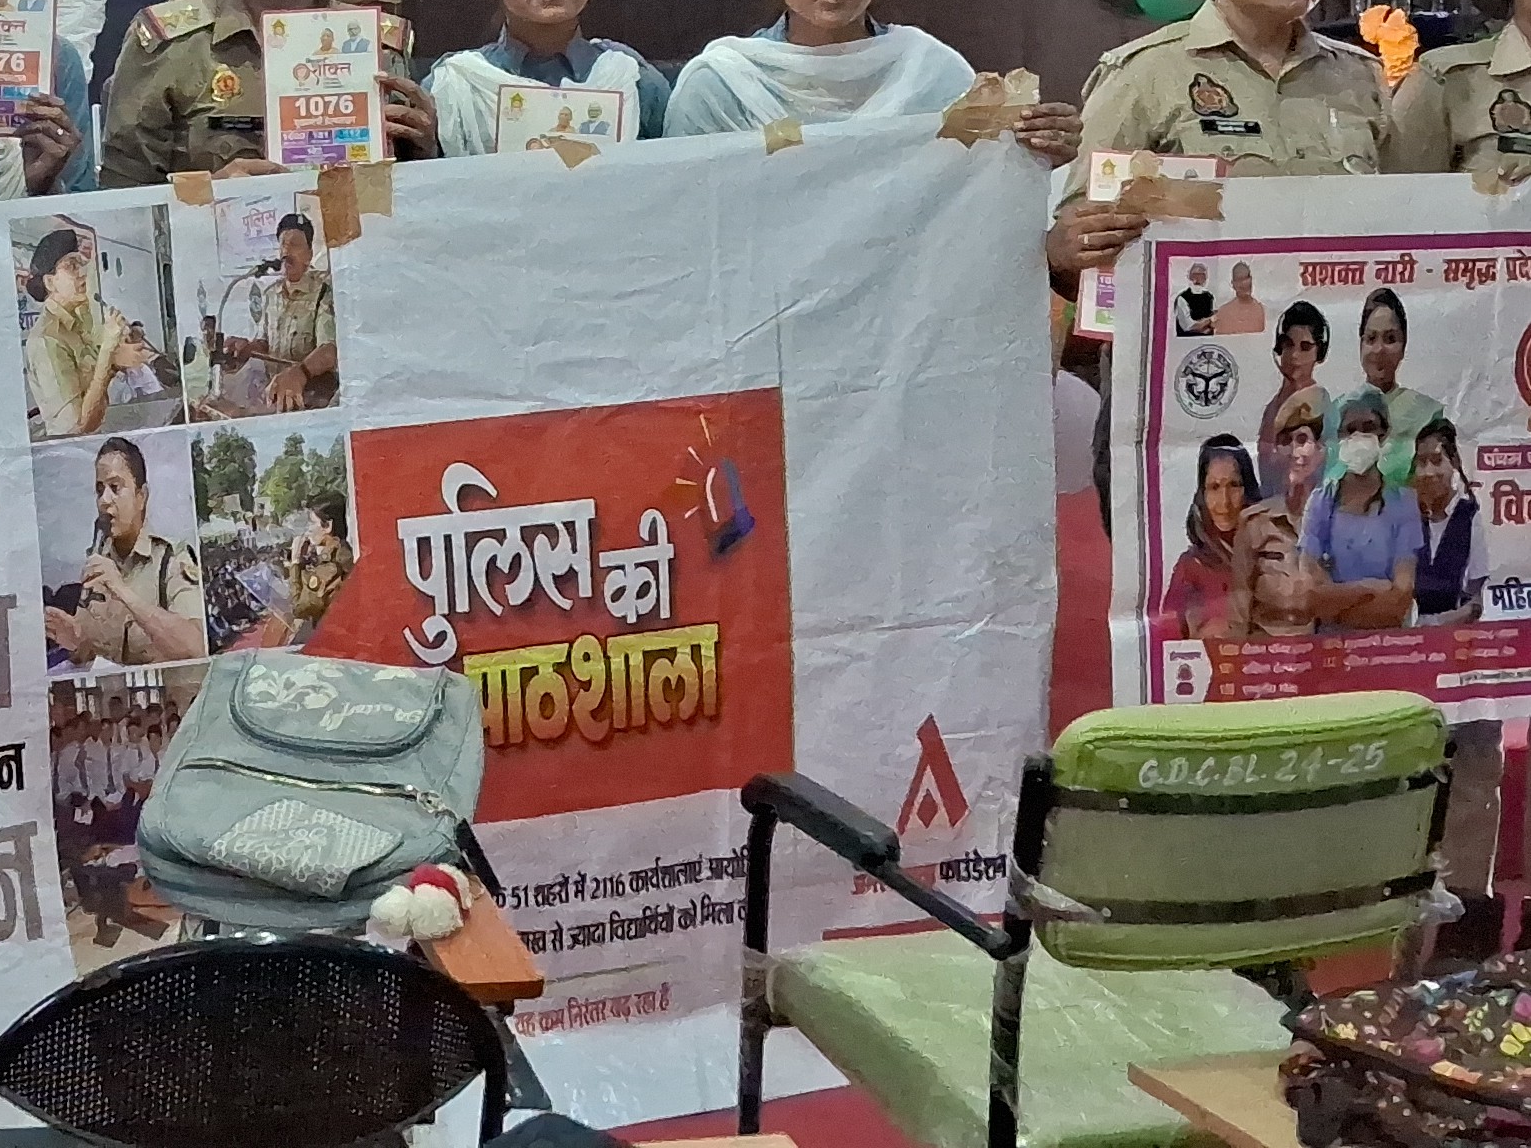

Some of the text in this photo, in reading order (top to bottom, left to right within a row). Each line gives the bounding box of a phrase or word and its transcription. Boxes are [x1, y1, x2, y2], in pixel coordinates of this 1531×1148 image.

[295, 95, 354, 117] 1076
[1299, 260, 1369, 286] सशक्त
[1374, 252, 1418, 284] नारी
[1442, 257, 1500, 290] समृद्ध
[1504, 249, 1531, 283] प्रदे
[396, 462, 675, 665] पुलिस की
[462, 622, 720, 748] पाठशाला
[1274, 740, 1389, 784] 24-25
[510, 883, 530, 910] 51
[573, 869, 588, 902] में
[590, 872, 626, 900] 2116
[549, 919, 564, 952] से
[567, 922, 606, 950] ज्यादा
[677, 898, 698, 930] को
[699, 892, 734, 926] मिला
[634, 990, 658, 1015] रहा
